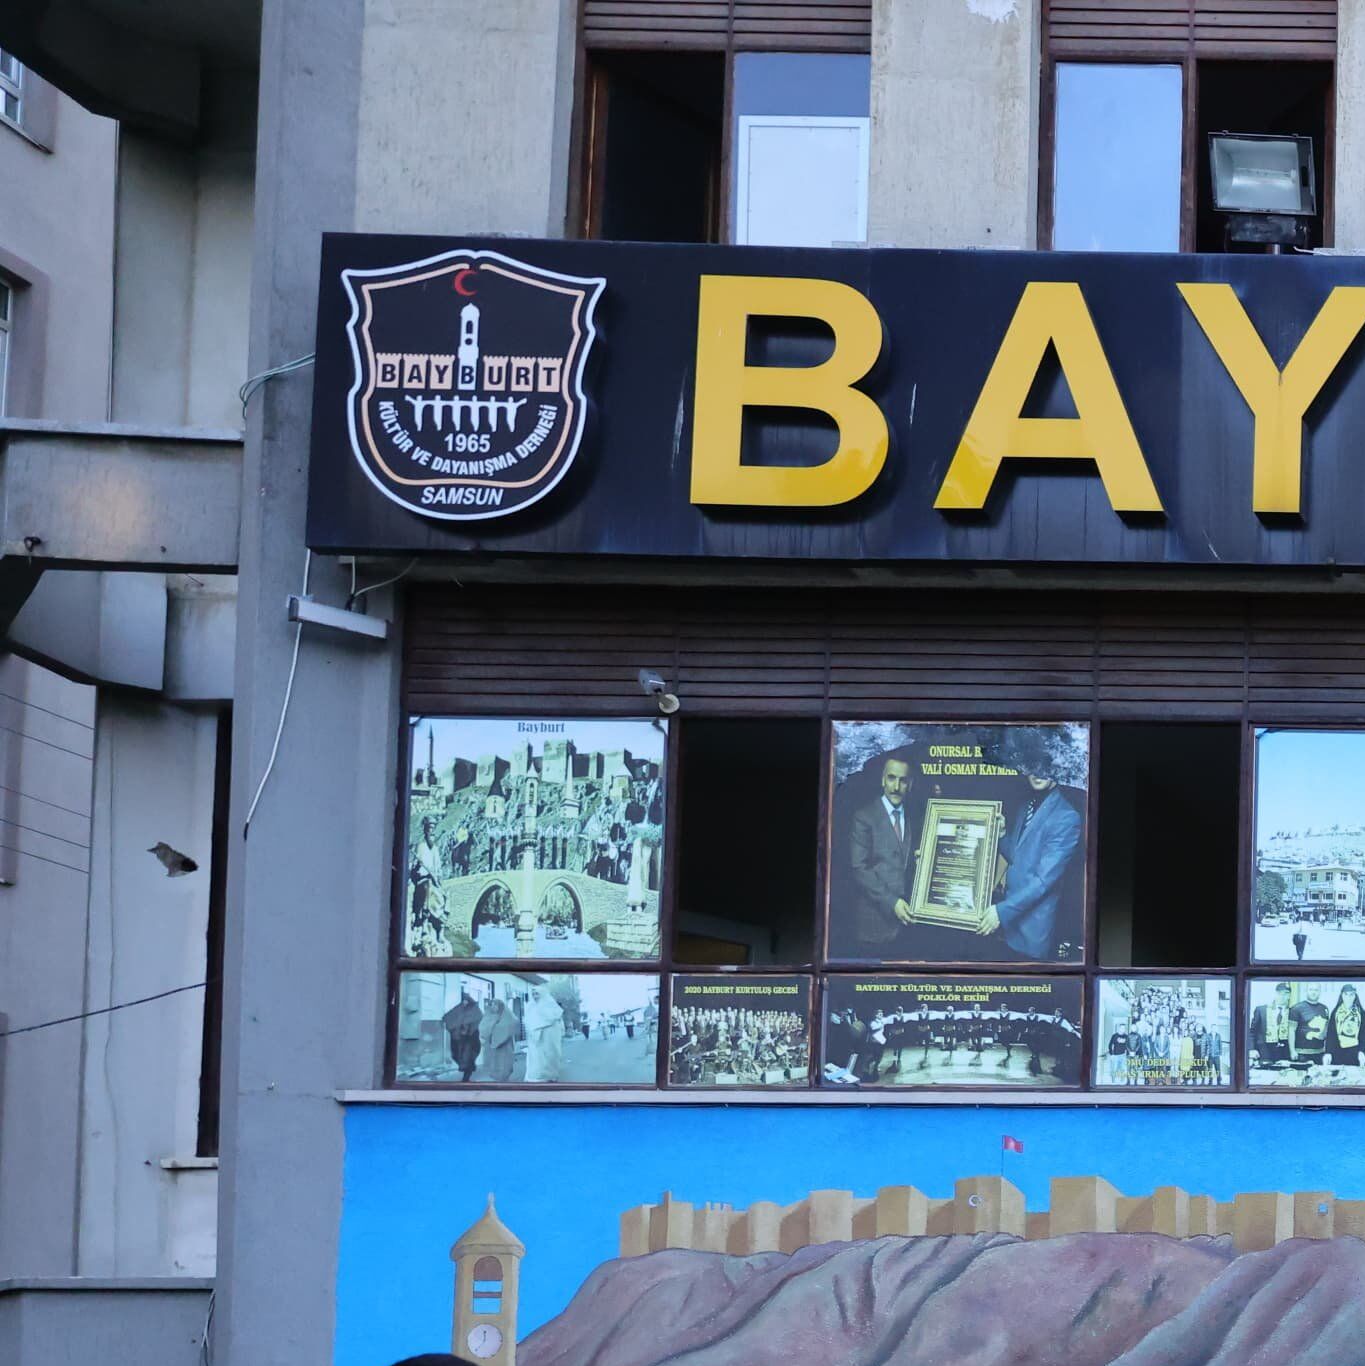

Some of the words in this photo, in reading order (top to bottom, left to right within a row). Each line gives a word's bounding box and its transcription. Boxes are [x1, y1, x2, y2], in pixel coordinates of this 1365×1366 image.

[381, 363, 557, 386] BAYBURT
[378, 401, 413, 453] KÜLTÜR
[411, 446, 432, 466] VE
[431, 452, 518, 477] DAYANIŞMA
[515, 404, 558, 460] DERNEĞİ
[444, 433, 491, 453] 1965
[421, 487, 504, 506] SAMSUN
[517, 722, 565, 733] Bayburt
[929, 745, 971, 757] ONURSAL
[921, 760, 942, 775] VALİ
[944, 764, 977, 775] OSMAN
[856, 984, 899, 992] BAYBURT
[900, 984, 938, 992] KÜLTÜR
[955, 985, 1008, 994] DAYANIŞMA
[1010, 984, 1051, 993] DERNEĞİ
[917, 993, 961, 1001] FOLKLÖR
[963, 993, 990, 1001] EKİBİ
